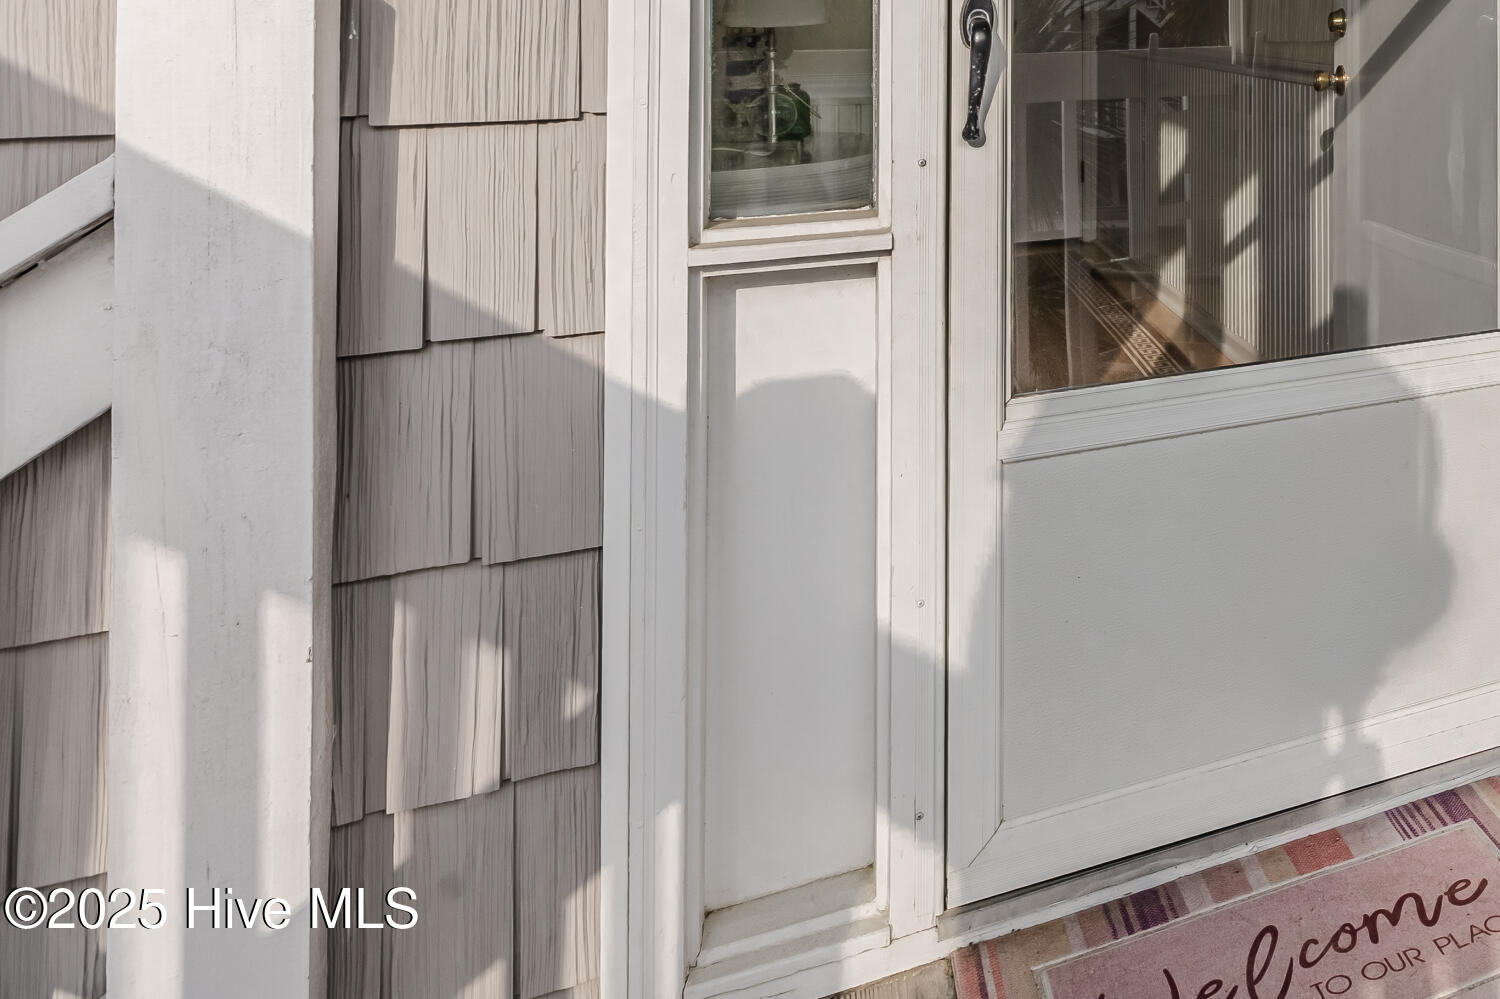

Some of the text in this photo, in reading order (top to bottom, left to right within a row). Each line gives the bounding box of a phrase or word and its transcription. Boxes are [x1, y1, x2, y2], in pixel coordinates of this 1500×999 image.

[1098, 877, 1489, 999] elcome
[1309, 974, 1353, 999] TO
[1361, 947, 1426, 981] OUR
